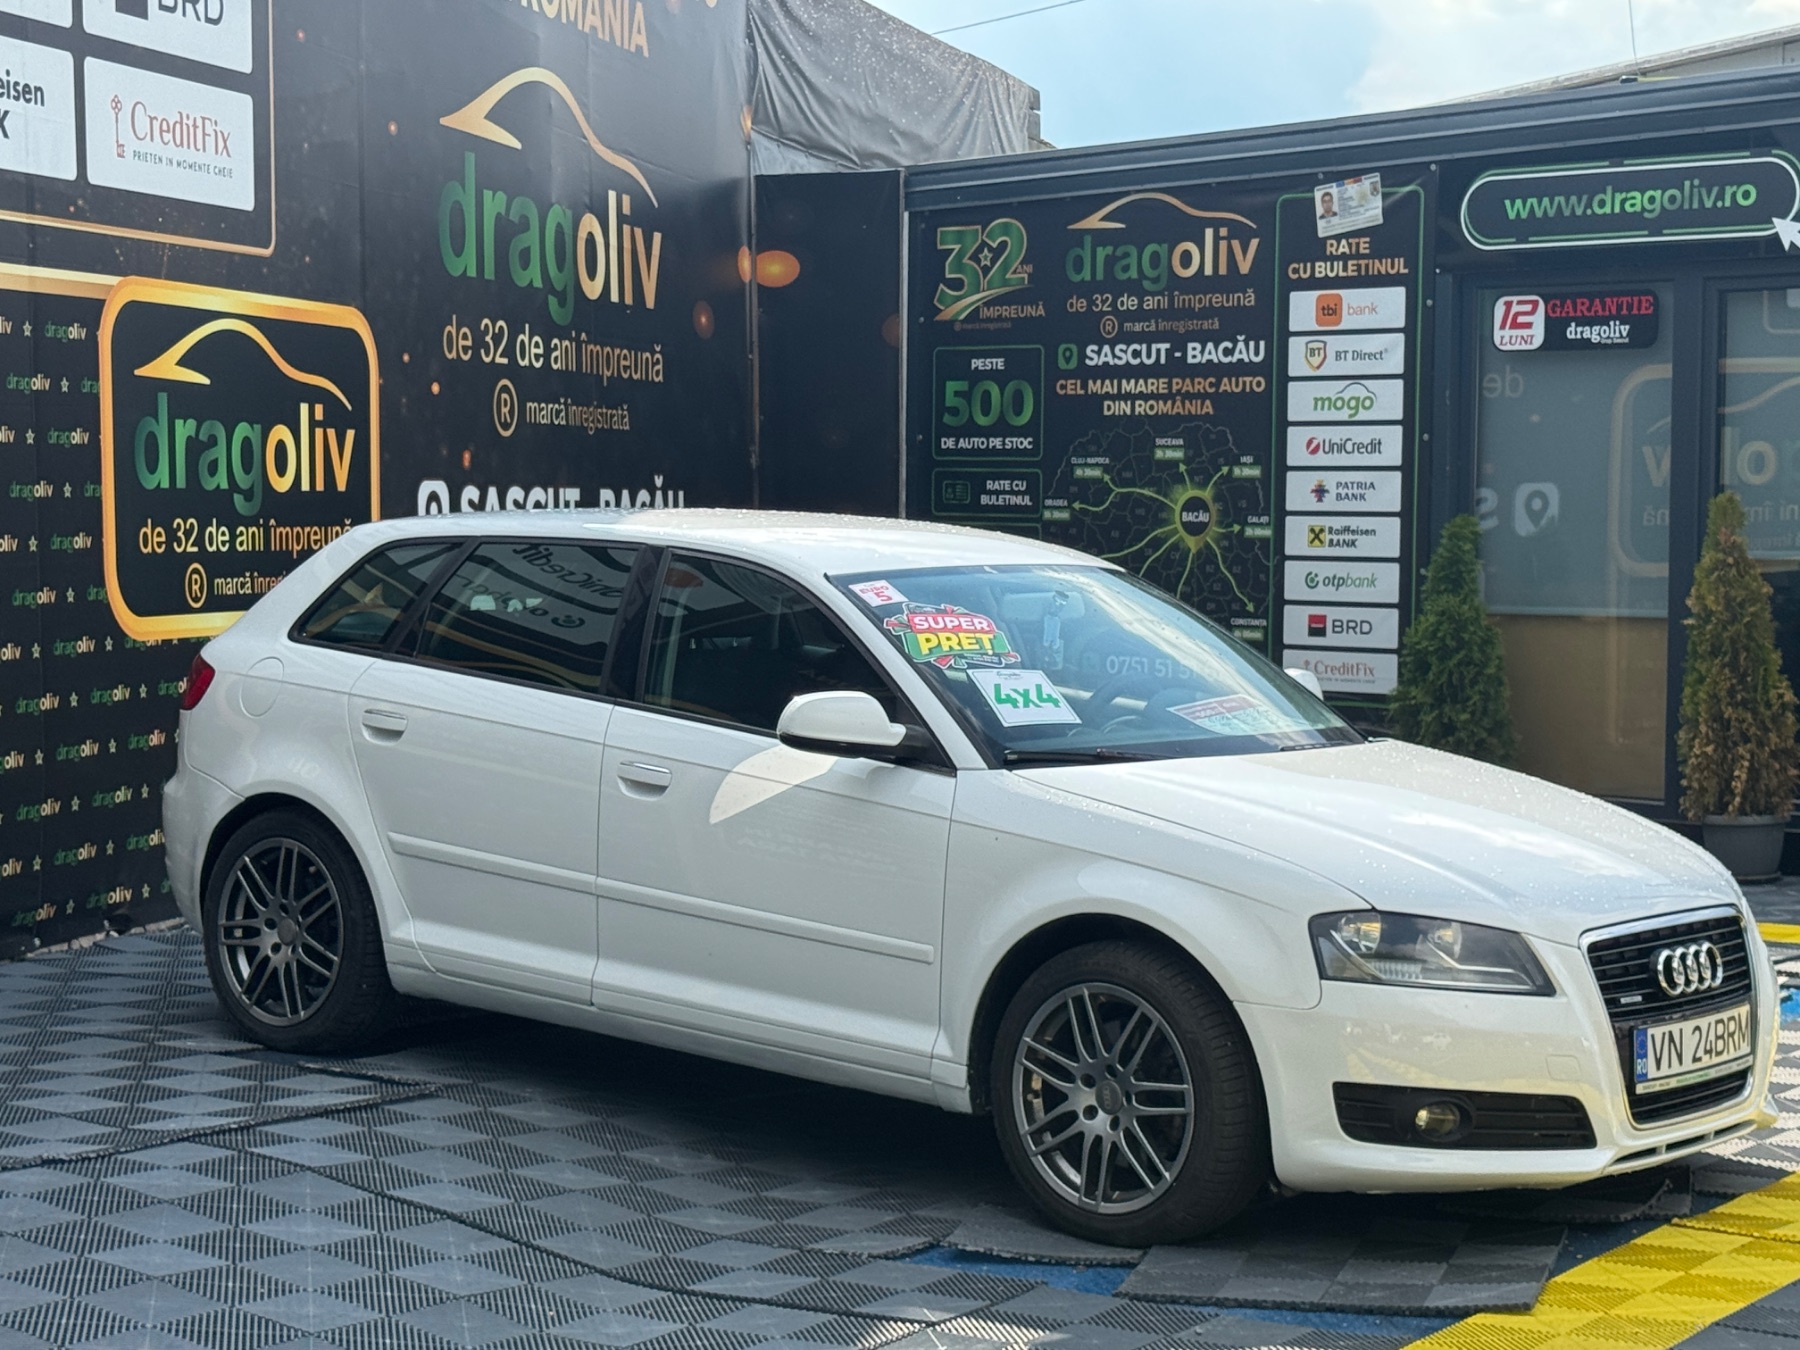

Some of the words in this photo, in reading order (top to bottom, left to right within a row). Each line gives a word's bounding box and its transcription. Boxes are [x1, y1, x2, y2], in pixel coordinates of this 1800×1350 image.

[0, 69, 45, 107] eisen
[130, 101, 232, 158] CreditFix
[133, 150, 163, 166] PRIETEN
[176, 159, 211, 175] MOMENTE
[213, 165, 233, 179] CHEIE
[1504, 178, 1758, 220] www.dragoliv.ro
[438, 151, 662, 326] dragoliv
[1326, 237, 1371, 255] RATE
[933, 218, 1027, 311] 32
[1016, 264, 1033, 274] ANI
[1065, 227, 1260, 291] dragoliv
[1288, 262, 1311, 280] CU
[1315, 257, 1409, 278] BULETINUL
[1066, 294, 1088, 313] de
[1092, 293, 1112, 311] 32
[1117, 292, 1138, 311] de
[1143, 290, 1169, 310] ani
[1174, 289, 1256, 314] împreună
[1321, 303, 1338, 316] tbi
[1347, 302, 1378, 316] bank
[1546, 295, 1654, 318] GARANTIE
[1123, 318, 1156, 332] marcă
[1158, 317, 1220, 334] înregistrată
[1498, 299, 1540, 331] 12
[44, 320, 87, 344] dragoliv
[1499, 334, 1534, 347] LUNI
[1566, 320, 1630, 343] dragoliv
[443, 314, 473, 361] de
[480, 318, 509, 365] 32
[516, 323, 544, 369] de
[550, 331, 577, 372] ani
[581, 332, 664, 386] împreună
[1085, 343, 1170, 367] SASCUT
[1187, 335, 1266, 365] BACĂU
[1309, 347, 1323, 358] BT
[1335, 350, 1349, 362] BT
[971, 358, 1005, 371] PESTE
[6, 374, 51, 394] dragoliv
[1056, 380, 1085, 395] CEL
[1089, 379, 1118, 394] MAI
[1121, 378, 1169, 394] MARE
[1172, 377, 1216, 393] PARC
[1219, 376, 1266, 393] AUTO
[942, 380, 1034, 426] 500
[1104, 401, 1131, 416] DIN
[1135, 397, 1214, 416] ROMÂNIA
[1312, 395, 1375, 419] mogo
[526, 397, 566, 426] marcă
[568, 398, 630, 435] înregistrată
[47, 427, 90, 448] dragoliv
[941, 437, 956, 450] DE
[958, 437, 987, 450] AUTO
[989, 437, 1003, 450] PE
[1005, 437, 1033, 449] STOC
[1155, 437, 1184, 446] SUCEAVA
[1322, 437, 1383, 455] UniCredit
[134, 392, 356, 516] dragoliv
[9, 480, 54, 501] dragoliv
[986, 480, 1011, 491] RATE
[1012, 480, 1027, 491] CU
[1335, 481, 1376, 491] PATRIA
[980, 494, 1033, 506] BULETINUL
[1335, 492, 1367, 502] BANK
[1181, 509, 1210, 522] BACĂU
[138, 518, 166, 554] de
[172, 518, 199, 553] 32
[204, 518, 230, 551] de
[235, 519, 264, 551] ani
[1327, 525, 1376, 537] Raiffeisen
[50, 533, 92, 554] dragoliv
[1328, 538, 1358, 549] BANK
[214, 572, 252, 596] marcă
[858, 584, 890, 595] EURO
[1322, 572, 1378, 591] otpbank
[11, 586, 56, 607] dragoliv
[873, 591, 893, 602] 5
[913, 616, 990, 631] SUPER
[1331, 618, 1373, 635] BRD
[53, 636, 96, 657] dragoliv
[1314, 659, 1375, 677] CreditFix
[15, 692, 60, 715] dragoliv
[90, 684, 131, 706] dragoliv
[56, 739, 99, 762] dragoliv
[128, 729, 166, 751] dragoliv
[16, 798, 61, 822] dragoliv
[92, 786, 133, 808] dragoliv
[54, 842, 97, 866] dragoliv
[12, 902, 57, 927] dragoliv
[86, 886, 132, 910] dragoliv
[1651, 1027, 1684, 1072] VN
[1637, 1058, 1648, 1074] RO
